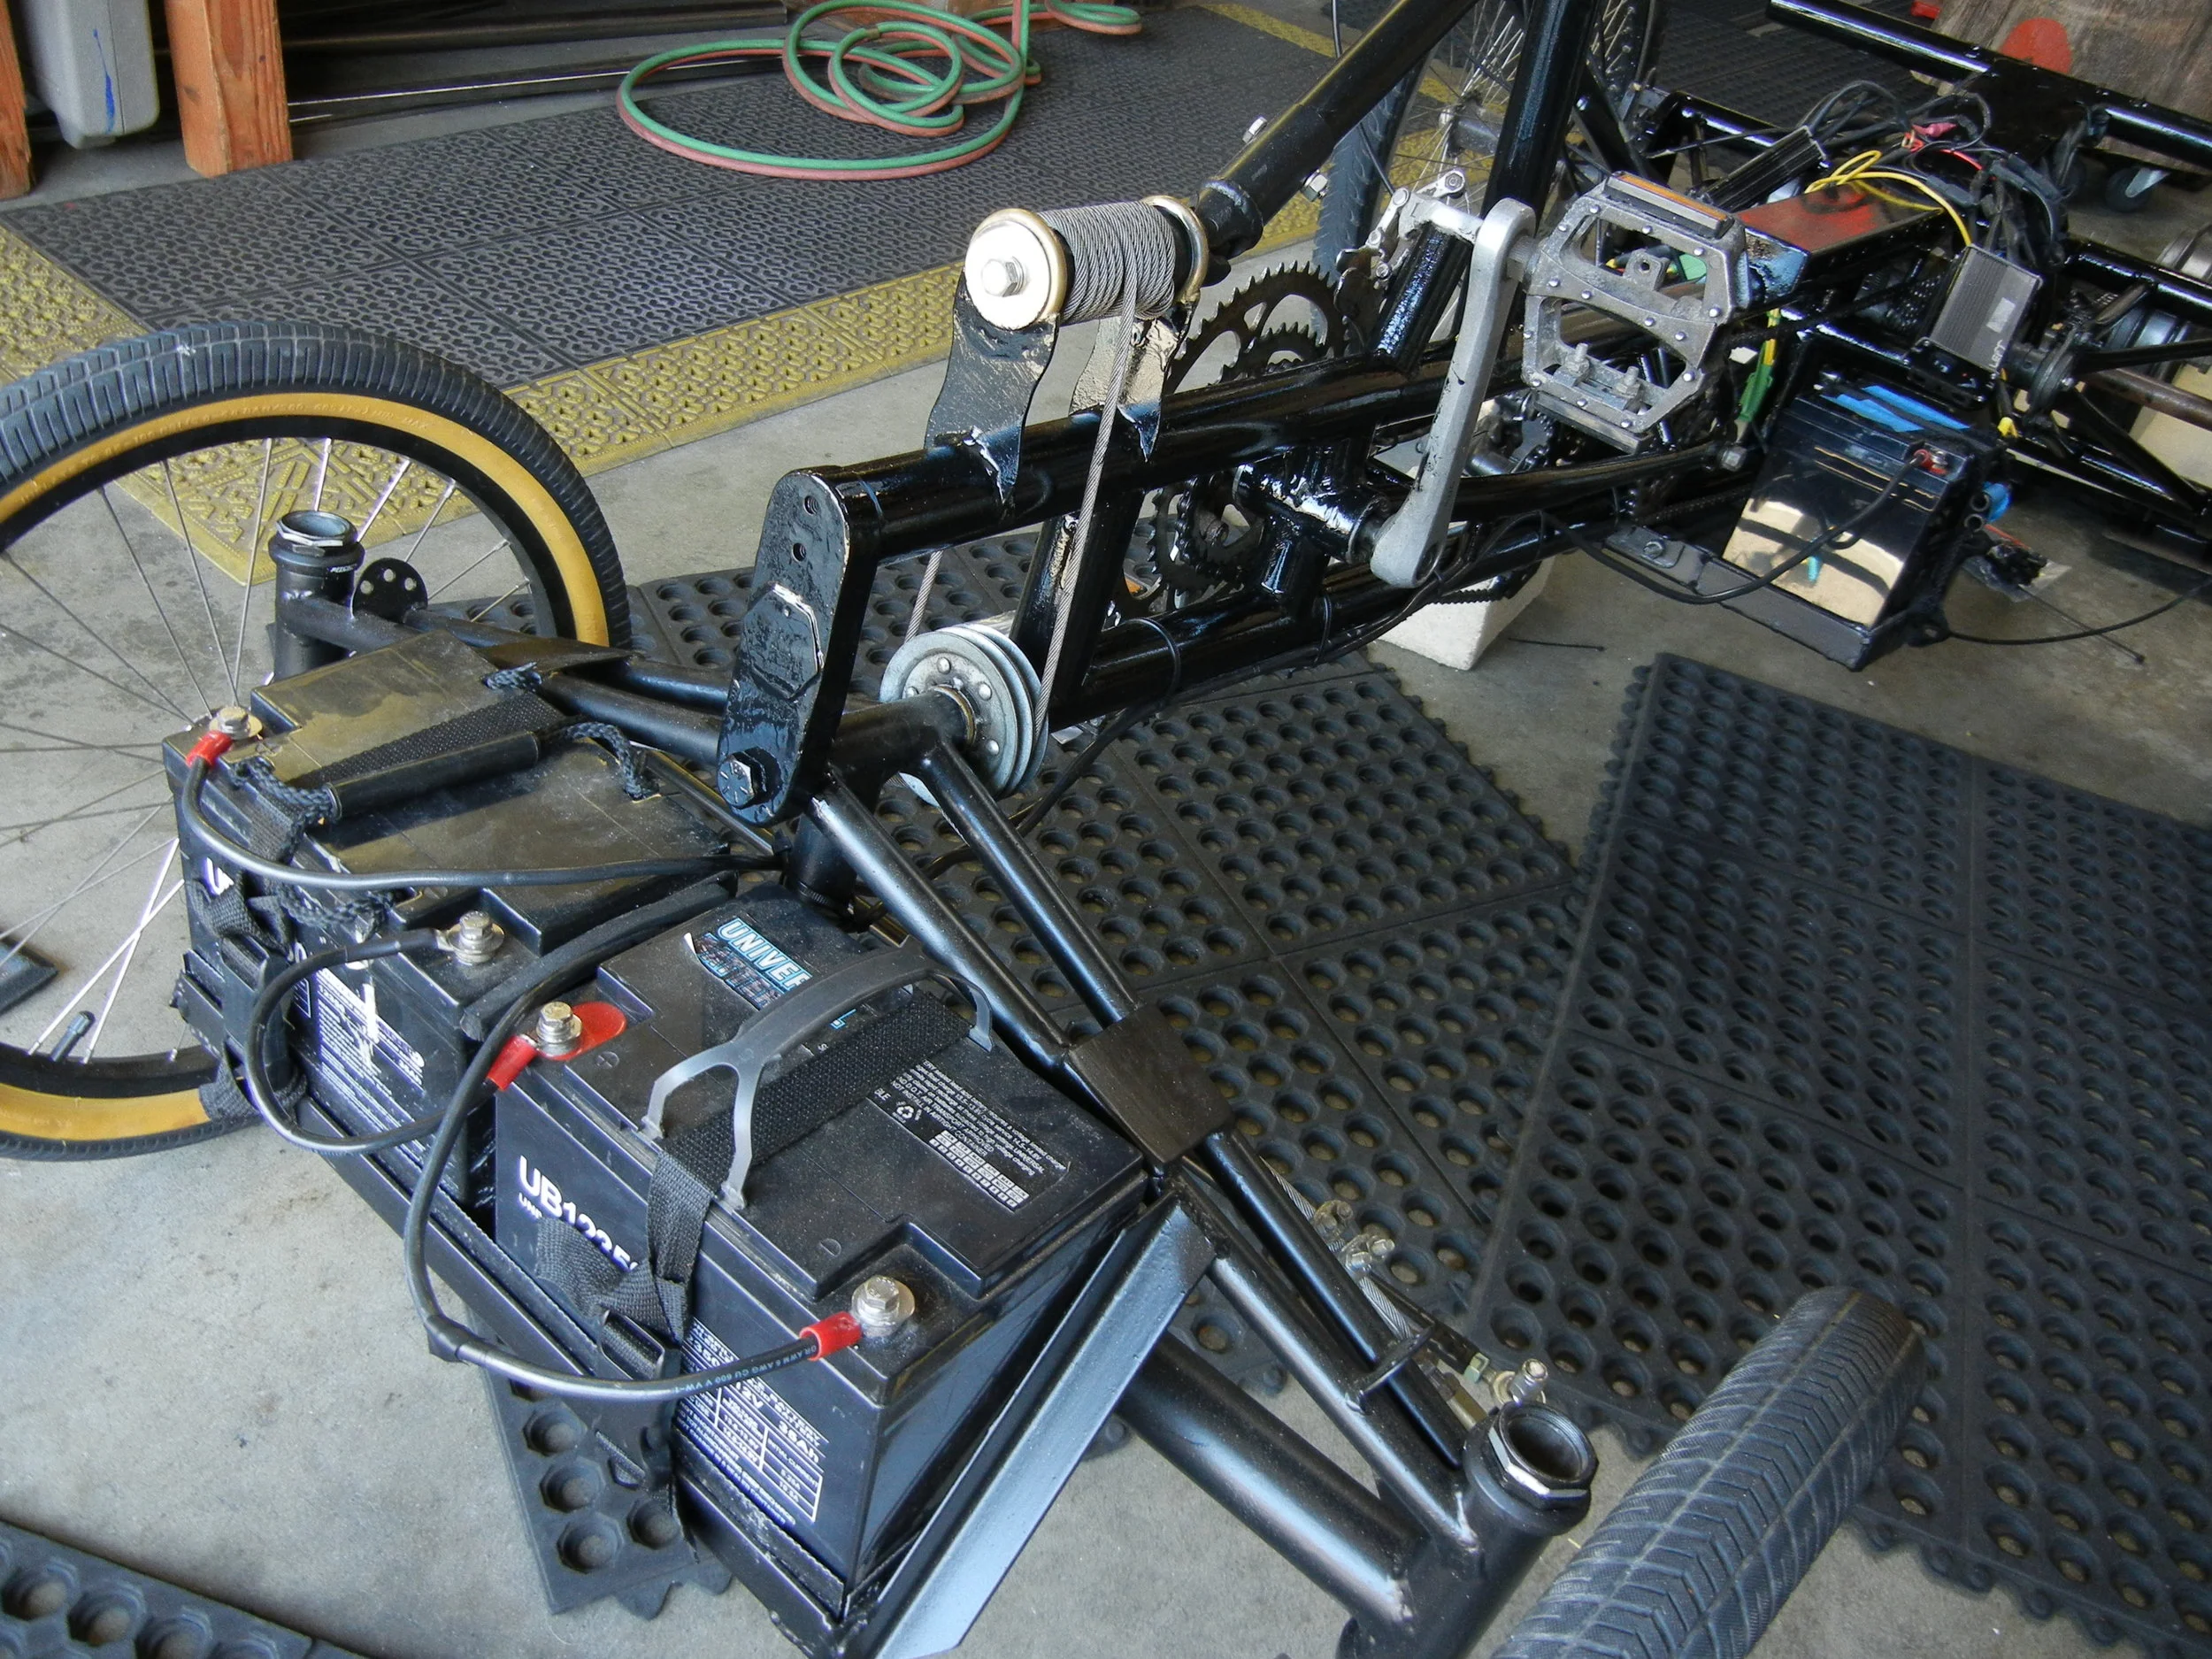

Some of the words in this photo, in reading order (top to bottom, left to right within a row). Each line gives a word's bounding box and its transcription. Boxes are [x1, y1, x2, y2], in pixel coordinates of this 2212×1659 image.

[889, 1079, 904, 1091] NOT
[901, 1089, 926, 1108] INSTALL
[928, 1110, 956, 1132] AIRTIGHT
[953, 1129, 988, 1156] CONTAINER
[908, 1067, 926, 1080] ermits
[962, 1109, 978, 1121] these
[974, 1119, 995, 1136] voltage
[920, 1094, 933, 1104] AIR
[930, 1102, 965, 1129] TRANSPORT
[962, 1127, 995, 1152] APPROVED
[922, 1060, 936, 1071] ERY
[933, 1069, 952, 1083] sealed
[949, 1080, 963, 1091] lead
[959, 1088, 972, 1099] acid
[969, 1096, 988, 1111] battery
[986, 1110, 1009, 1127] requires
[1010, 1127, 1031, 1144] voltage
[1028, 1141, 1048, 1156] limited
[936, 1080, 956, 1095] charge
[993, 1124, 1013, 1140] service
[992, 1142, 1014, 1159] voltage
[1010, 1156, 1036, 1176] charging
[518, 1155, 639, 1272] UB1235
[715, 1372, 733, 1384] 600
[734, 1368, 749, 1379] CU
[751, 1360, 776, 1374] AWG
[783, 1351, 803, 1364] AWM
[778, 1417, 819, 1464] 35Ah
